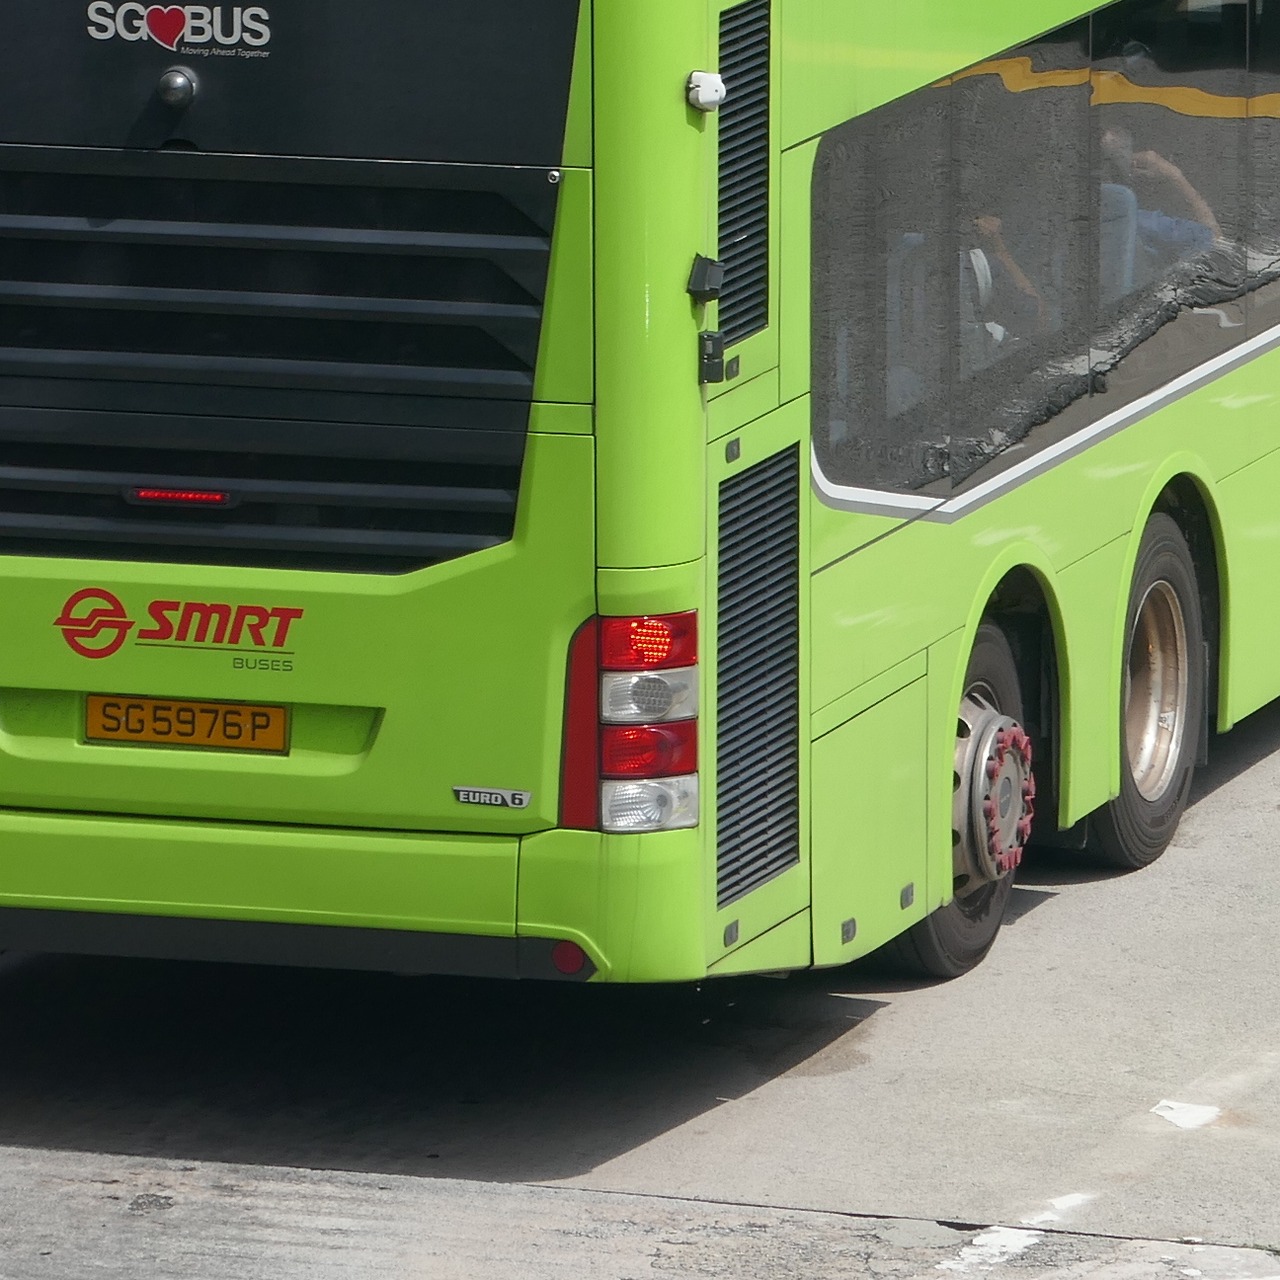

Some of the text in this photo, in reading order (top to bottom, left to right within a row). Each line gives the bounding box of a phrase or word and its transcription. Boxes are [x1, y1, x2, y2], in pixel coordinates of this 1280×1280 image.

[180, 46, 271, 59] Moving Ahead Together
[136, 599, 304, 648] SMRT
[232, 657, 294, 672] BUSES
[459, 791, 524, 806] EURO 6
